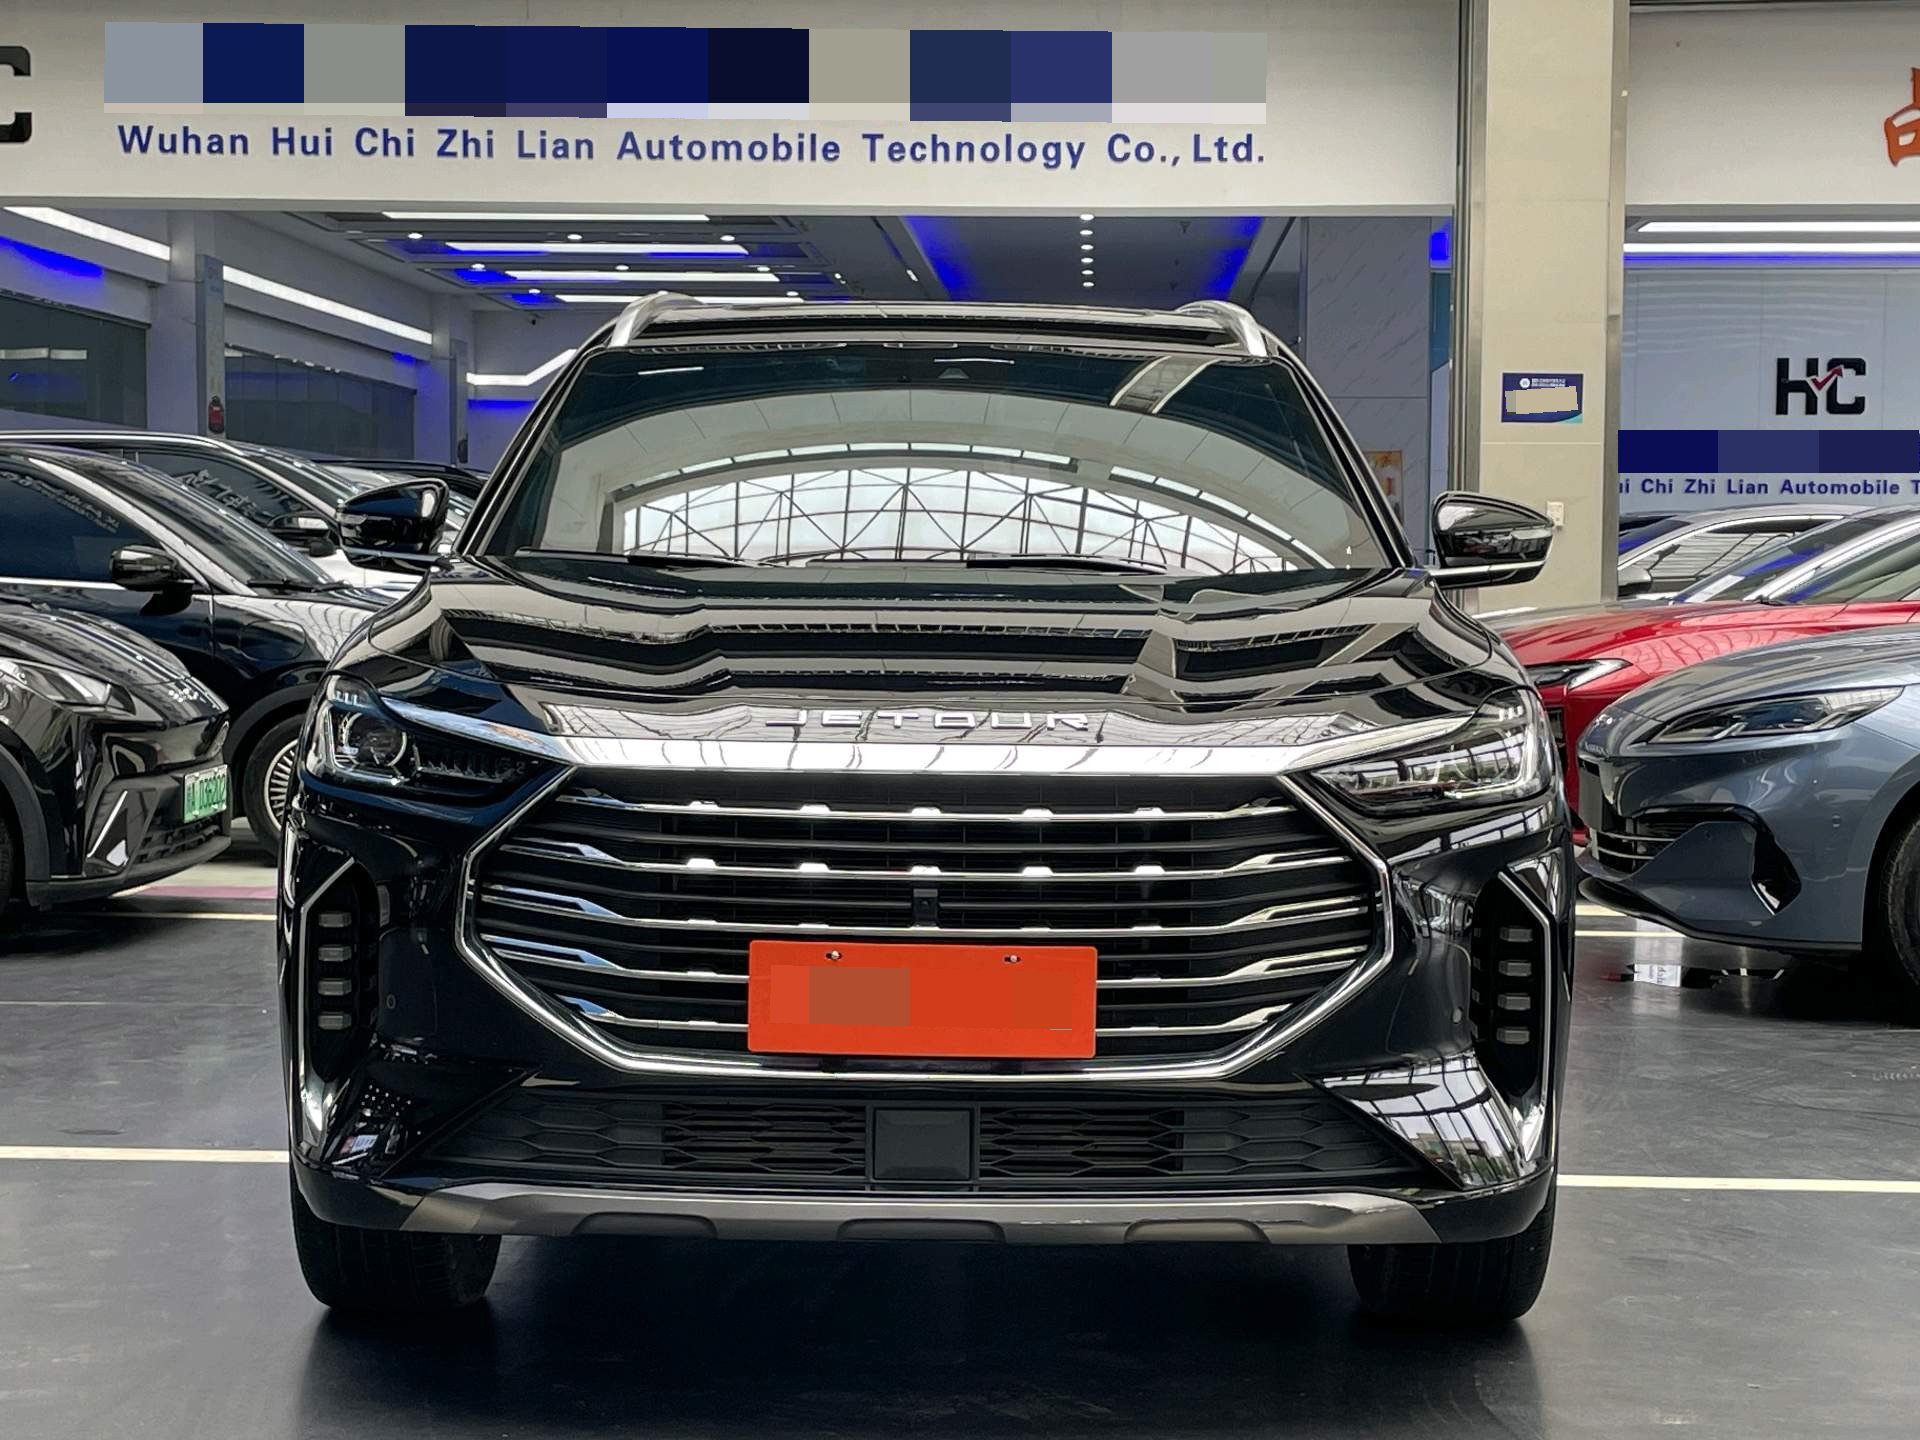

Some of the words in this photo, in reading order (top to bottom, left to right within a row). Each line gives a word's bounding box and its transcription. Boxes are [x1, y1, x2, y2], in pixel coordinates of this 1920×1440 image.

[117, 124, 250, 156] Wuhan
[271, 125, 333, 157] Hui
[355, 126, 416, 158] Chi
[436, 128, 495, 160] Zhi
[517, 129, 595, 161] Lian
[616, 130, 842, 162] Automobile
[861, 132, 1086, 169] Technology
[1775, 357, 1867, 416] HC
[1641, 478, 1673, 494] Chi
[1683, 478, 1716, 495] Zhi
[1726, 478, 1769, 495] Lian
[1779, 478, 1901, 495] Automobile
[766, 709, 1089, 731] JETOUR
